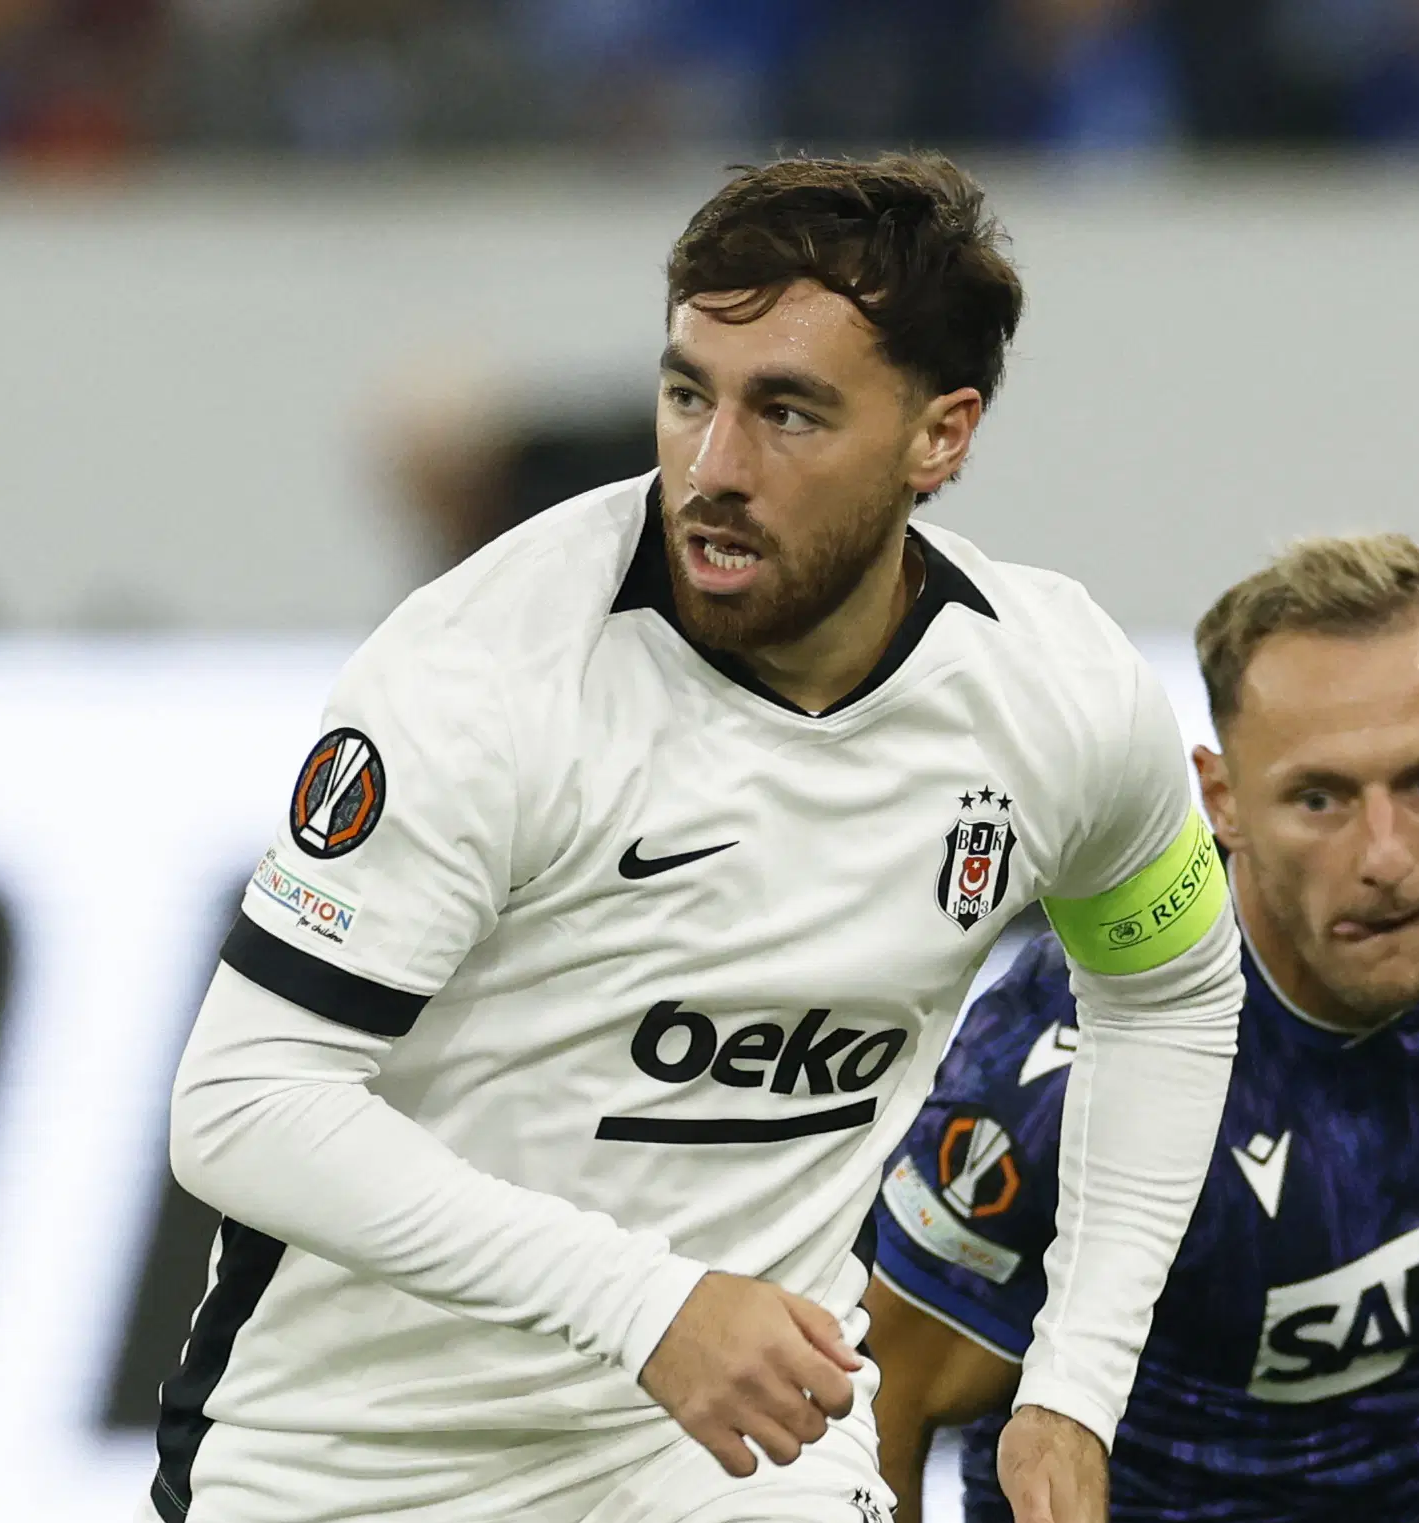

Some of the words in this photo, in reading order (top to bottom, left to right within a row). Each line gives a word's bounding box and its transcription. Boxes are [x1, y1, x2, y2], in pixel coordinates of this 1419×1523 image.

[957, 828, 1005, 852] BJK
[1151, 820, 1213, 927] RESPEC
[951, 900, 989, 915] 1903
[630, 1000, 908, 1095] beko
